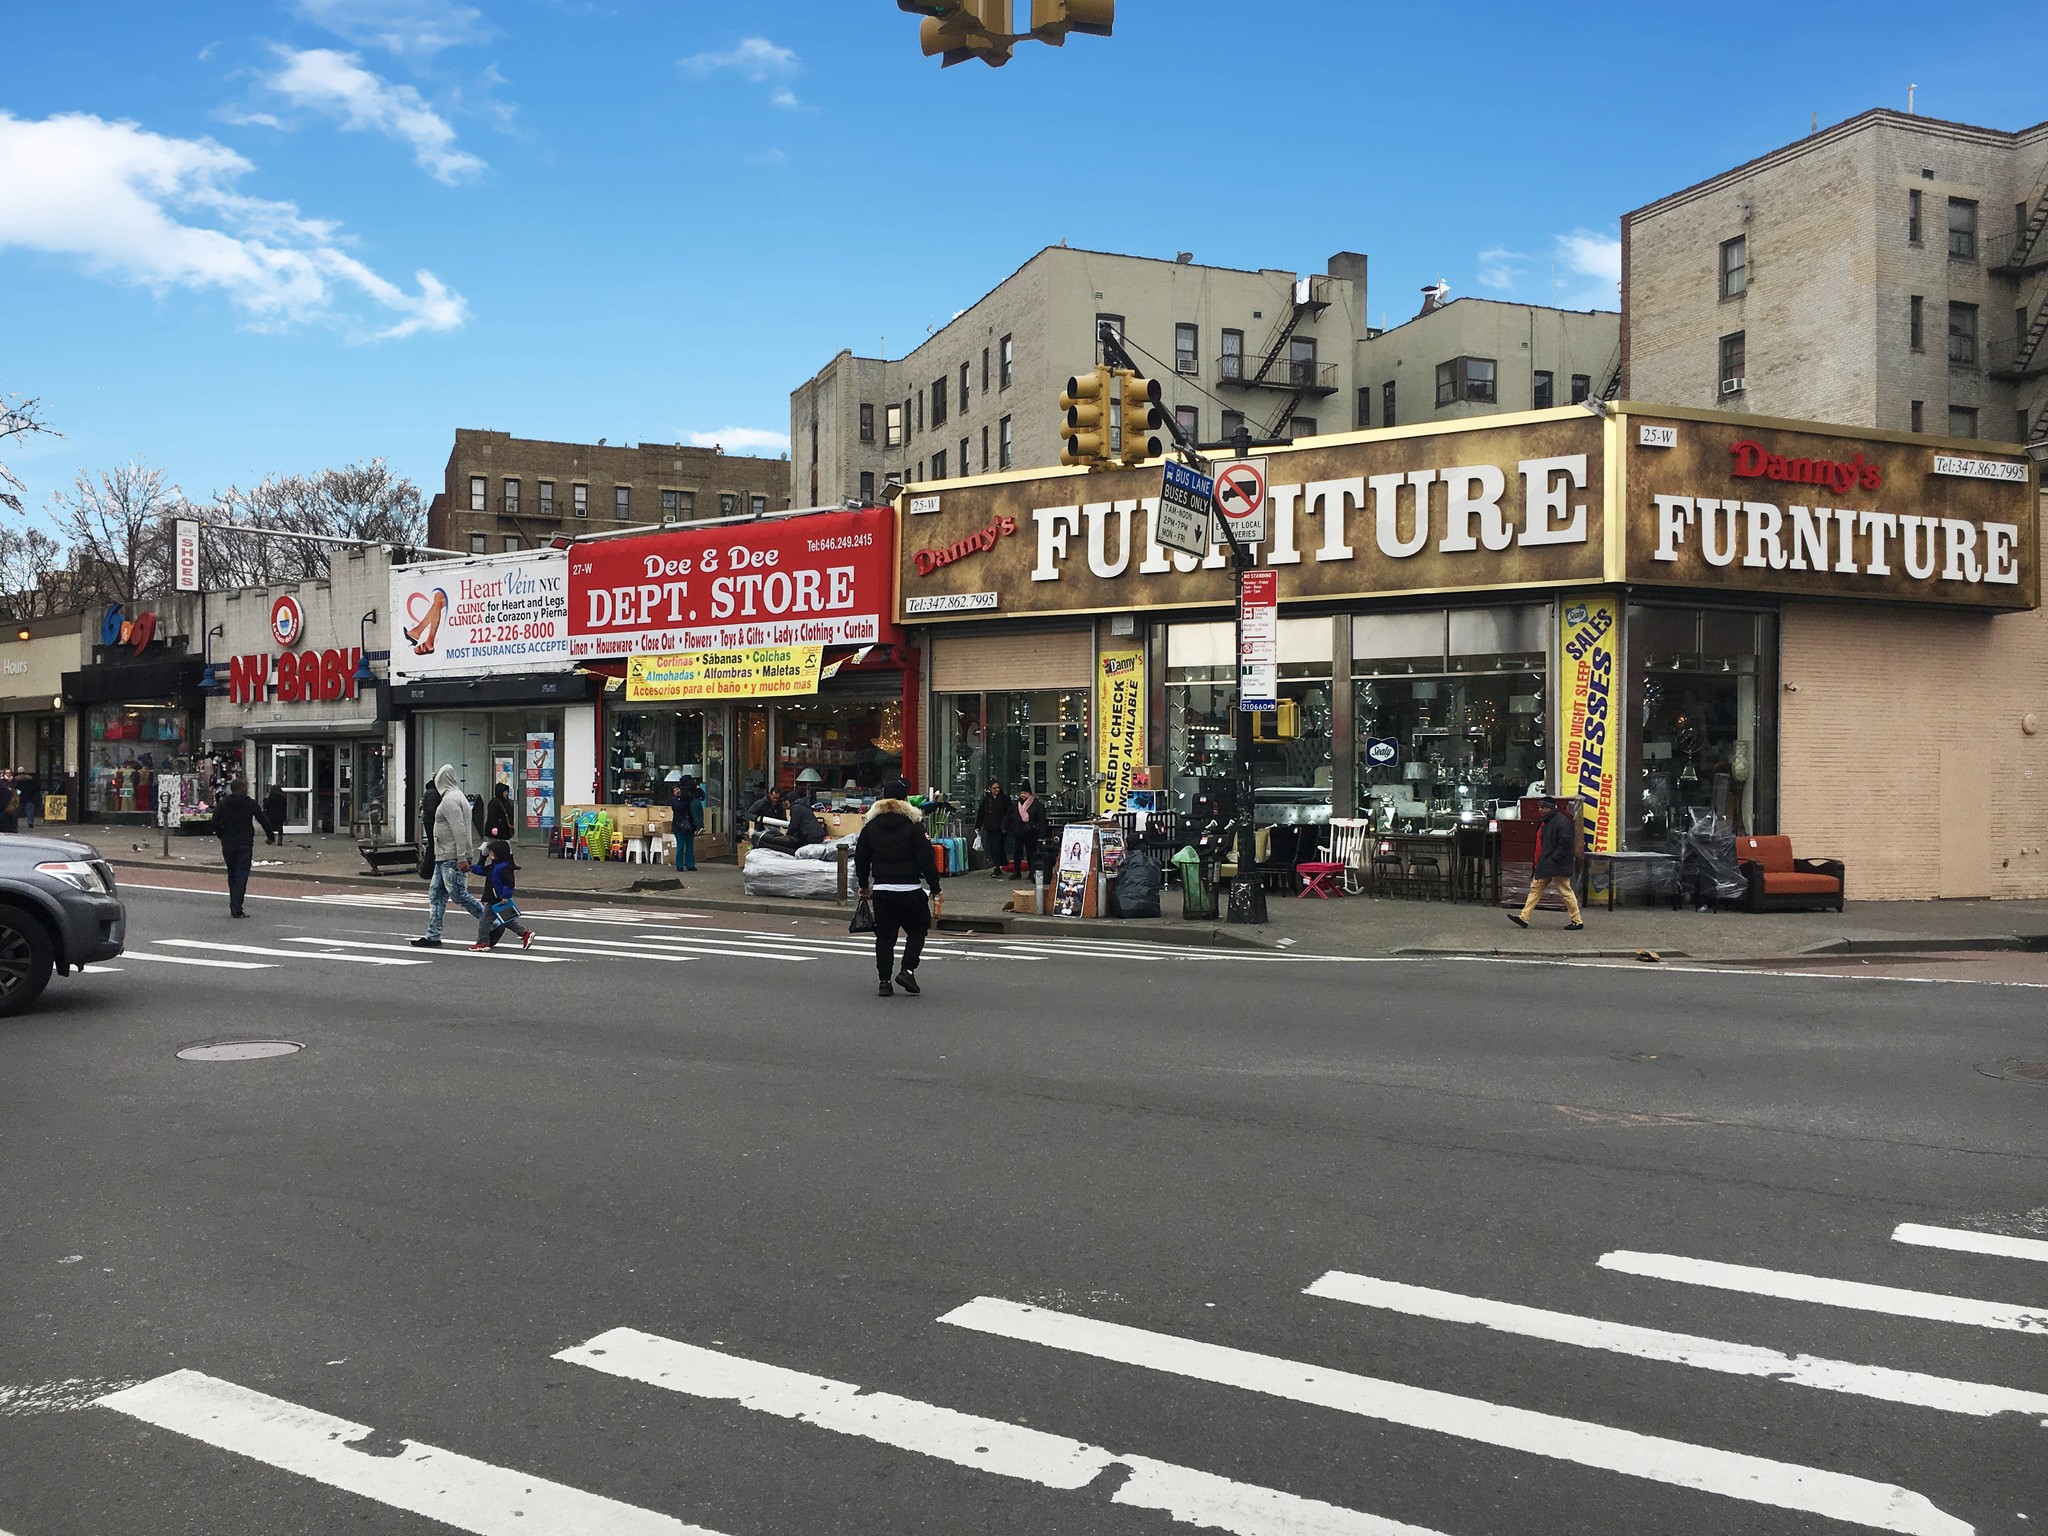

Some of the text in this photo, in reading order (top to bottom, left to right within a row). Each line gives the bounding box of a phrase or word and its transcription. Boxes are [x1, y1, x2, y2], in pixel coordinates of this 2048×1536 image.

[1643, 428, 1673, 443] 25-W
[1729, 439, 1882, 494] Danny's
[1936, 458, 2024, 479] Tel:347.862.7995
[1175, 468, 1210, 495] BUS LANE
[913, 500, 936, 511] 25-W
[1164, 484, 1209, 513] BUSES ONLY
[1031, 454, 1587, 581] FUITURE
[1216, 520, 1261, 530] EPT LOCAL
[807, 533, 873, 552] Tel:646.249.2415
[912, 514, 1017, 576] Danny's
[1221, 530, 1256, 539] DVERIES
[1654, 494, 2018, 584] FURNITURE
[181, 538, 194, 586] SHOES
[573, 563, 592, 575] 27-W
[644, 545, 779, 578] Dee & Dee
[460, 567, 560, 599] Heart Vein NYC
[457, 596, 564, 614] CLINIC for Heart and Legs
[587, 566, 854, 627] DEPT. STORE
[909, 594, 995, 611] Tel:347.862.7995
[449, 614, 483, 626] CLINICA
[485, 613, 495, 623] de
[498, 610, 531, 622] Corazon
[533, 611, 539, 622] y
[470, 621, 555, 644] 212-226-8000
[570, 640, 588, 655] Linen
[596, 638, 633, 654] Houseware
[641, 634, 659, 651] Close
[661, 633, 675, 650] Out
[685, 632, 712, 648] Flowers
[720, 629, 736, 649] Toys
[738, 627, 745, 645] &
[746, 627, 764, 645] Gifts
[800, 622, 833, 644] Clothing
[844, 619, 873, 639] Curtain
[1566, 608, 1612, 660] SALES
[446, 640, 568, 659] MOST INSURANCES ACCEPTE
[656, 650, 791, 668] Cortinas Sábanas Colchas
[4, 659, 28, 674] Hours
[230, 647, 360, 703] NY BABY
[646, 664, 800, 682] Almohadas Alfombras Maletas
[1107, 654, 1143, 673] Danny's
[633, 684, 680, 696] Accesorios
[682, 684, 702, 695] para
[705, 682, 714, 693] el
[717, 681, 740, 693] baño
[751, 682, 756, 694] y
[759, 679, 790, 692] mucho
[793, 679, 811, 689] mas
[1111, 680, 1125, 738] CHECK
[1566, 660, 1590, 774] GOOD NIGHT SLEEP
[1118, 680, 1138, 812] NCING AVAILABLE
[1371, 746, 1392, 758] Sealy
[1105, 743, 1119, 804] CREDIT
